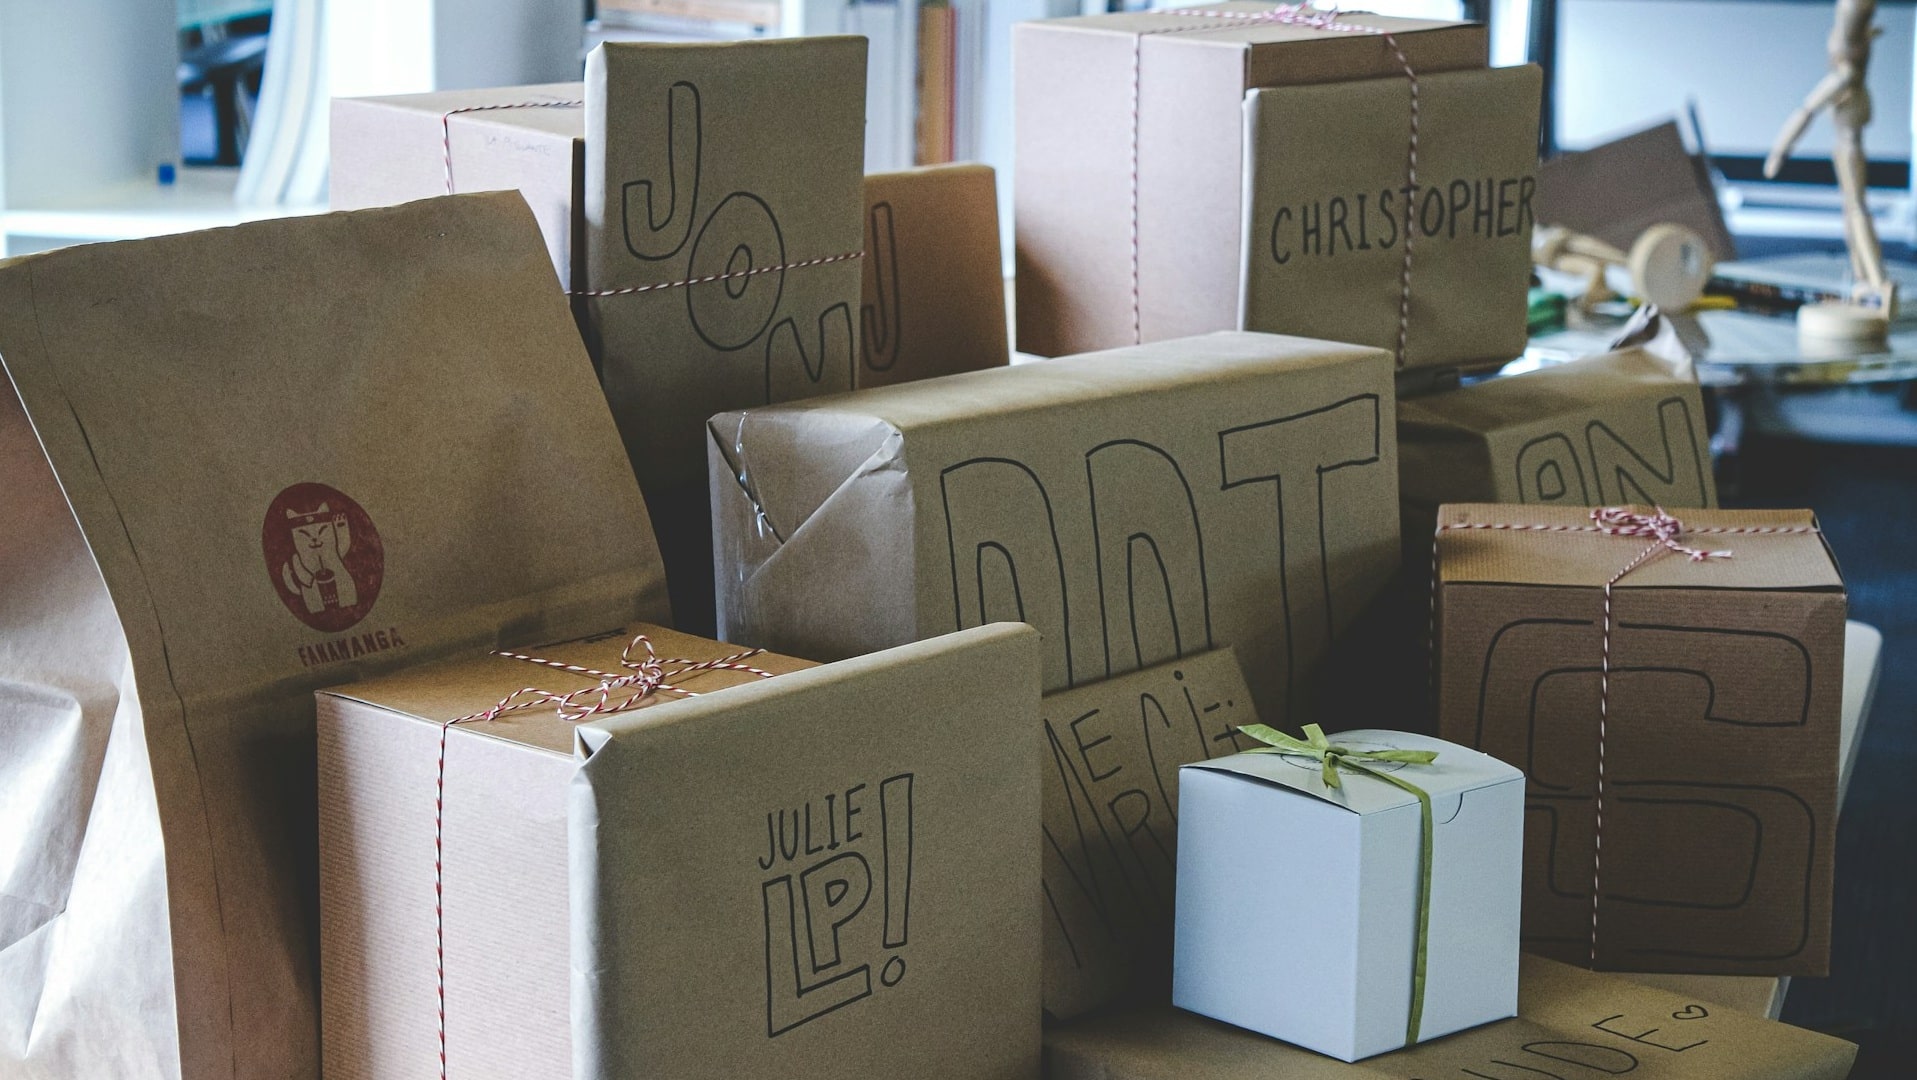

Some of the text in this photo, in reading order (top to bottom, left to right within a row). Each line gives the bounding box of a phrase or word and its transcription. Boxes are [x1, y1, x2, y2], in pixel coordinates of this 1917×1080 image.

[1271, 175, 1537, 264] CHRISTOPHER
[758, 783, 866, 870] JULIE
[762, 773, 914, 1038] LP!
